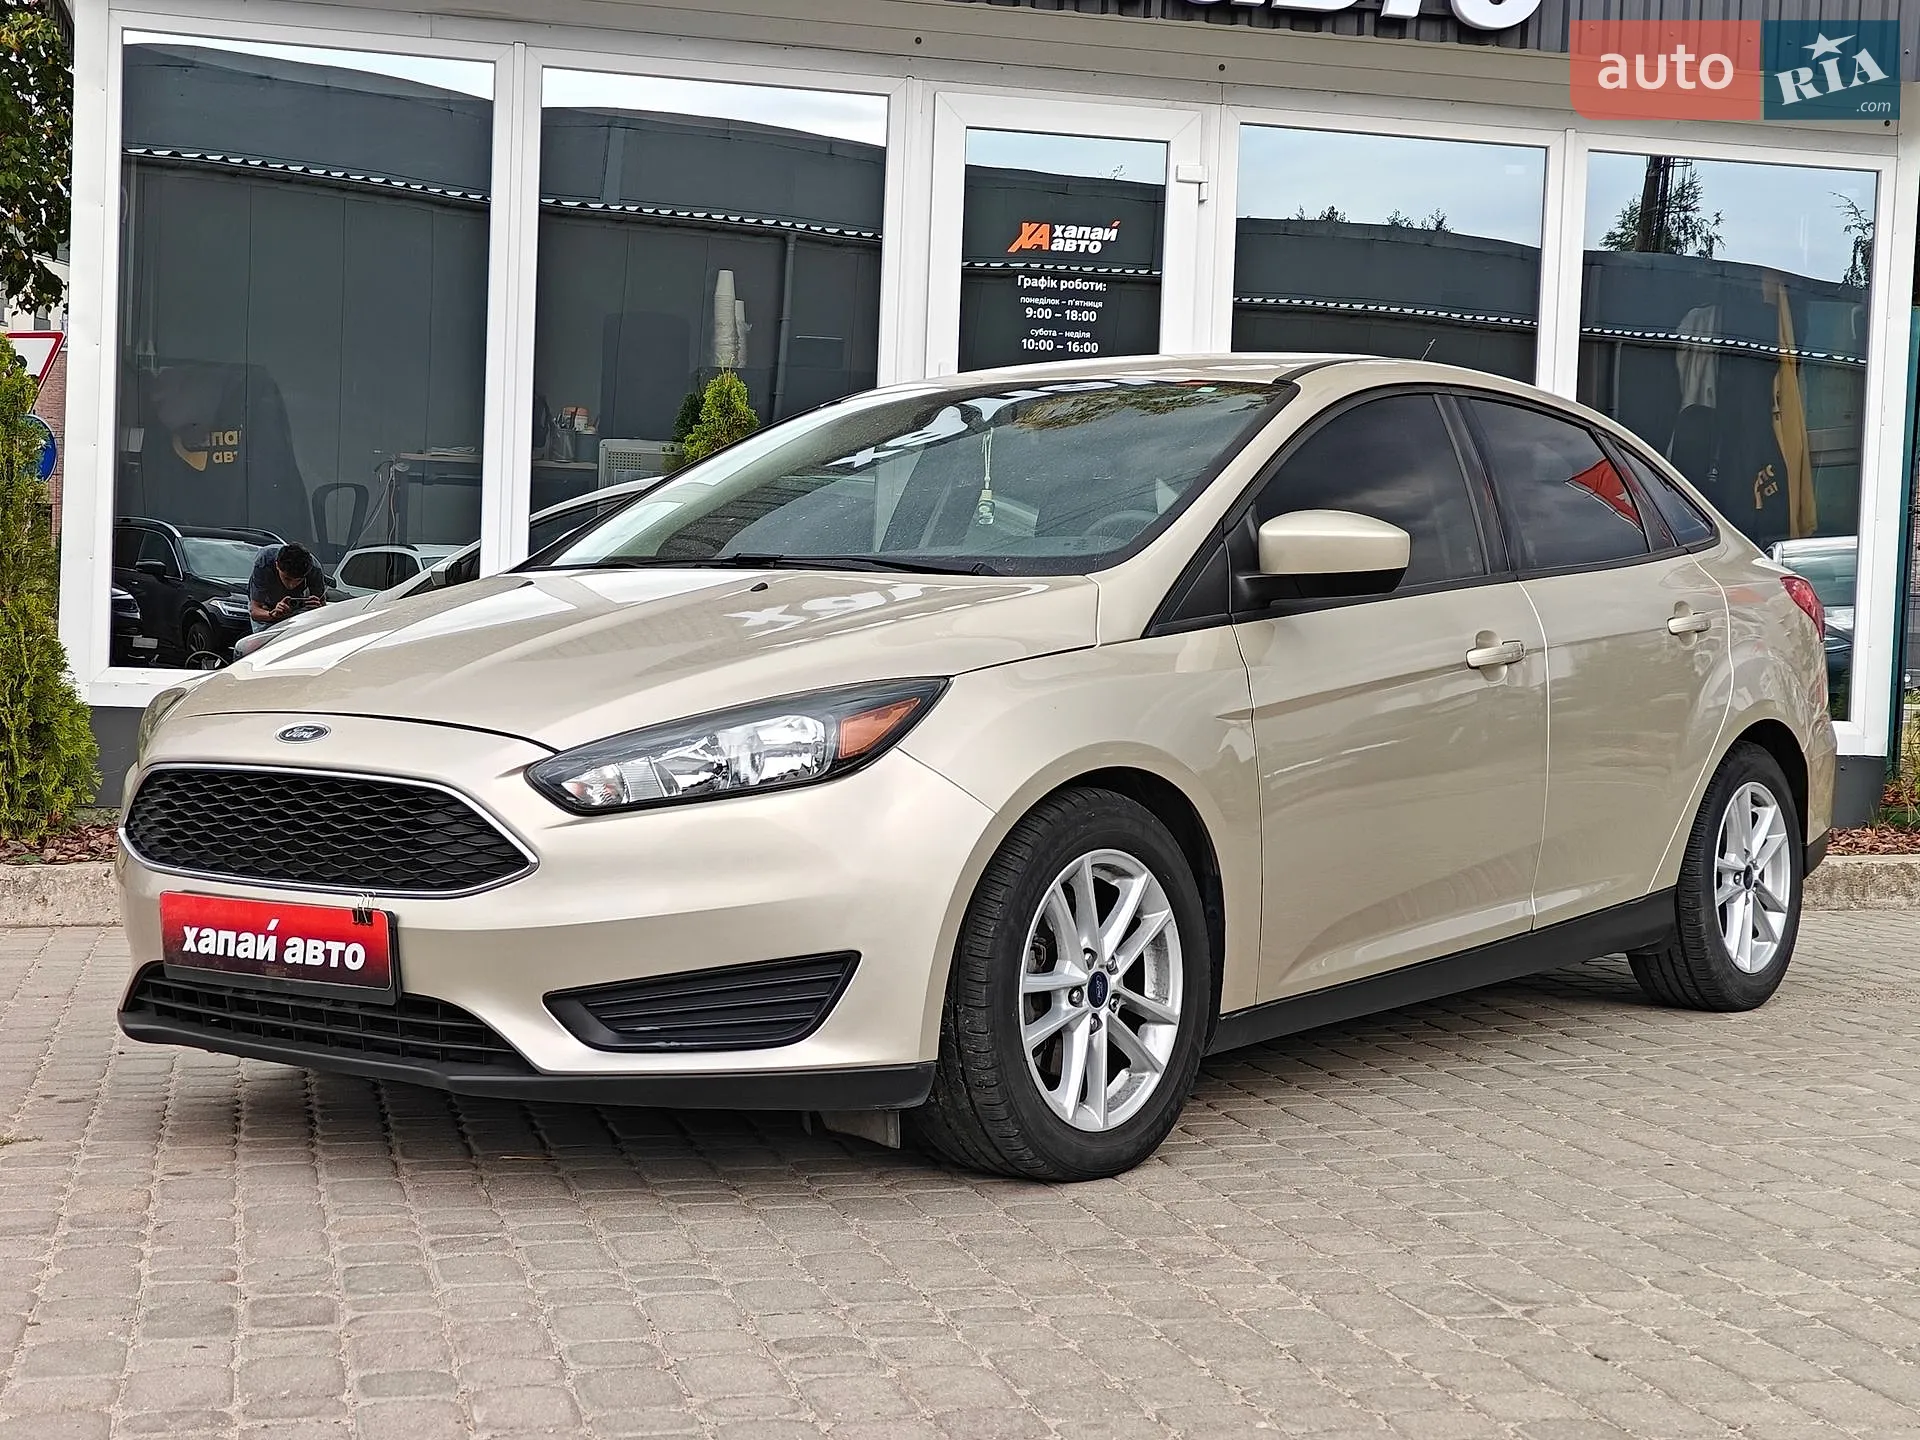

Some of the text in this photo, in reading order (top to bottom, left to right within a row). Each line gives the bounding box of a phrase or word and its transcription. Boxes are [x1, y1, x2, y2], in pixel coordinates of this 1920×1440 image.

[1050, 238, 1102, 254] авто
[1017, 274, 1107, 291] Графік роботи:
[1020, 296, 1060, 306] понеділок
[1025, 307, 1052, 319] 9:00
[1064, 309, 1097, 322] 18:00
[1030, 328, 1057, 337] субота
[1064, 330, 1091, 338] неділя
[1021, 338, 1054, 351] 10:00
[1066, 341, 1099, 353] 16:00
[285, 727, 319, 739] Ford
[283, 936, 367, 971] авто
